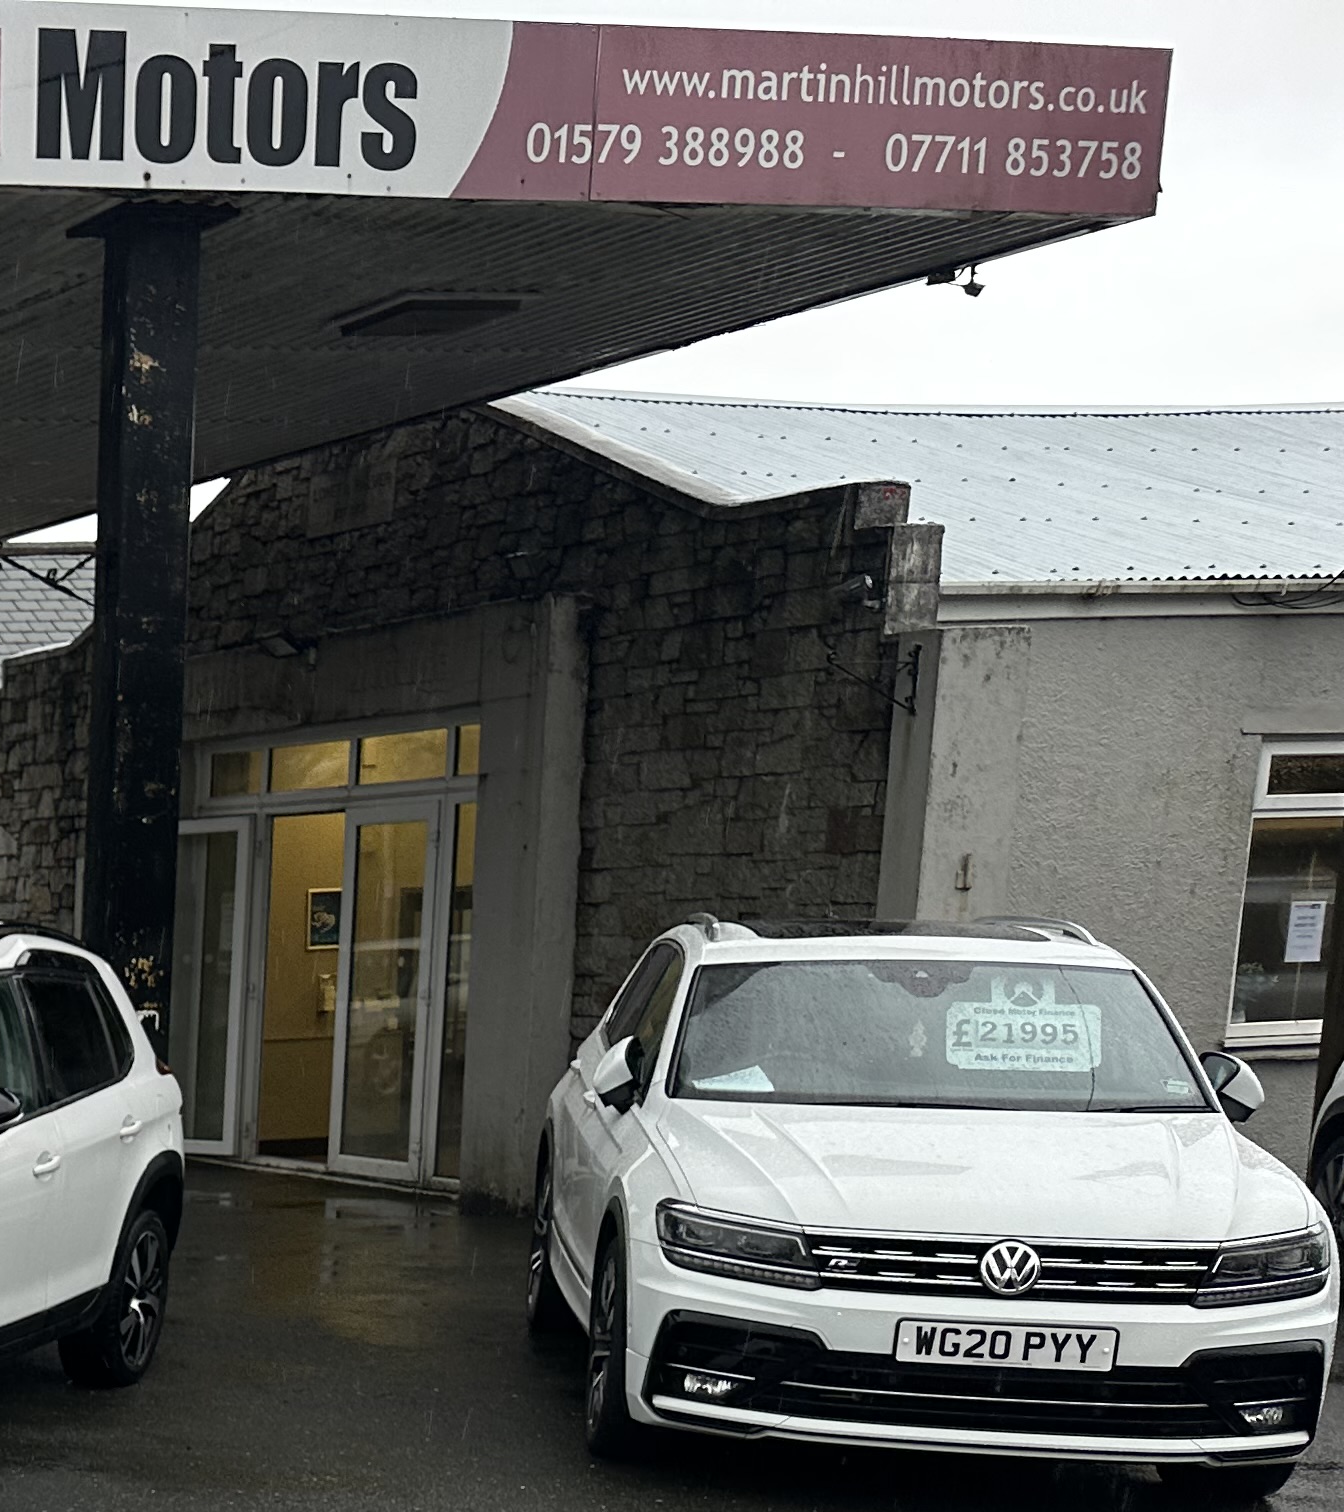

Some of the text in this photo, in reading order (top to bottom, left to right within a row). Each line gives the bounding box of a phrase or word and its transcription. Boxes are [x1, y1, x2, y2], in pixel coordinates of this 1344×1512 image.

[35, 27, 418, 171] Motors
[622, 63, 1147, 115] www.martinhillmotors.co.uk
[525, 121, 642, 165] 01579
[658, 124, 805, 170] 388988
[885, 132, 987, 175] 07711
[1004, 136, 1143, 181] 853758
[951, 1018, 1079, 1048] £21995
[974, 1053, 1074, 1065] Ask For Finance
[915, 1325, 1098, 1364] WG20 PYY
